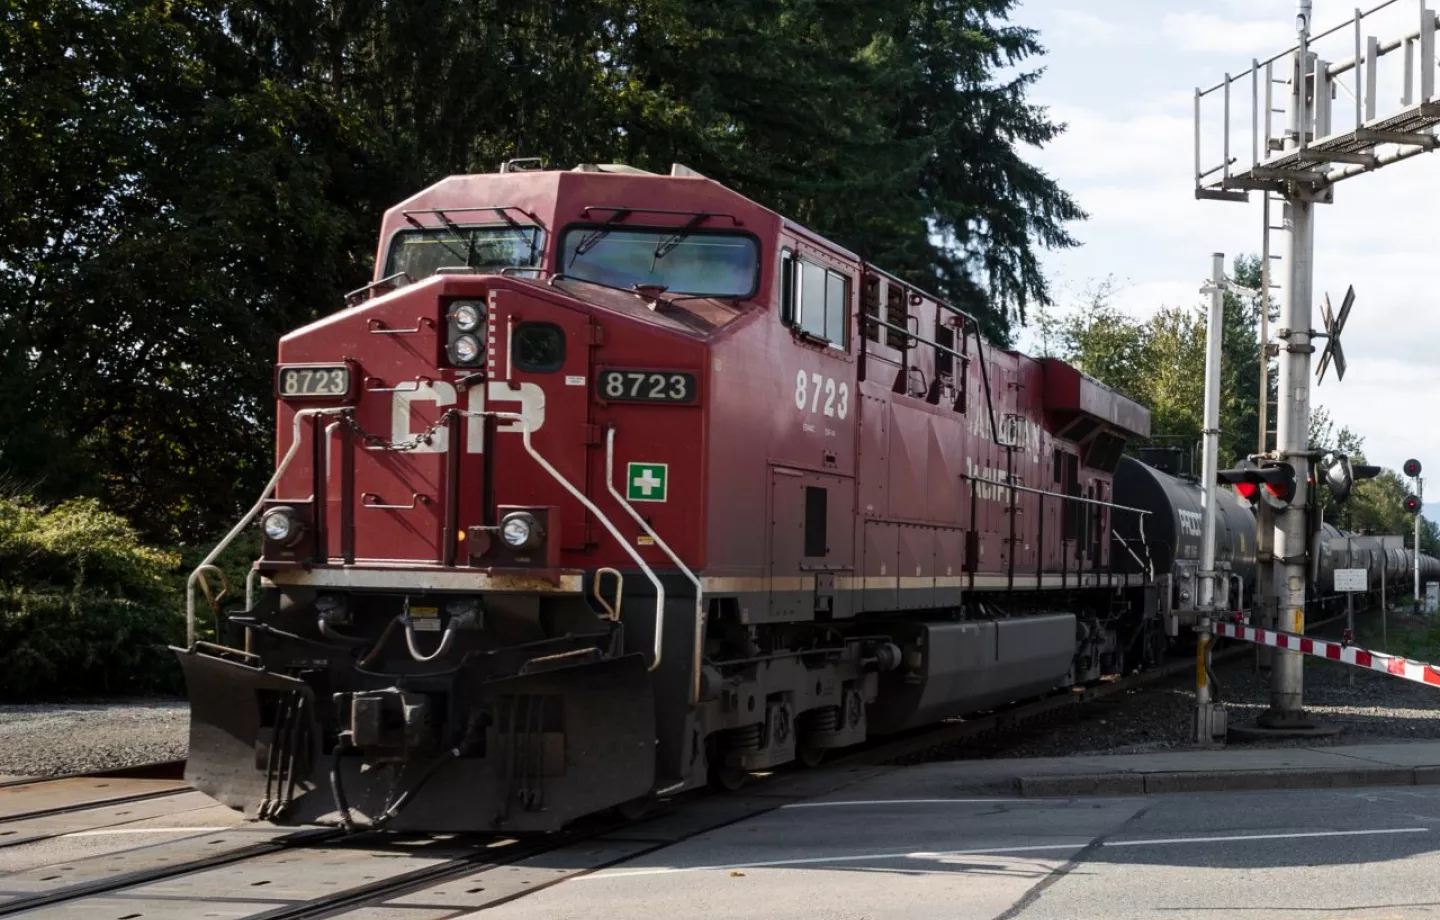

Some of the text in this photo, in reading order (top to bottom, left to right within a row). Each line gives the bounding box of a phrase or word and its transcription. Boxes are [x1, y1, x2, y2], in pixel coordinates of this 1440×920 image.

[285, 369, 344, 394] 8723
[605, 372, 687, 399] 8723
[795, 369, 848, 420] 8723
[392, 381, 546, 454] CP
